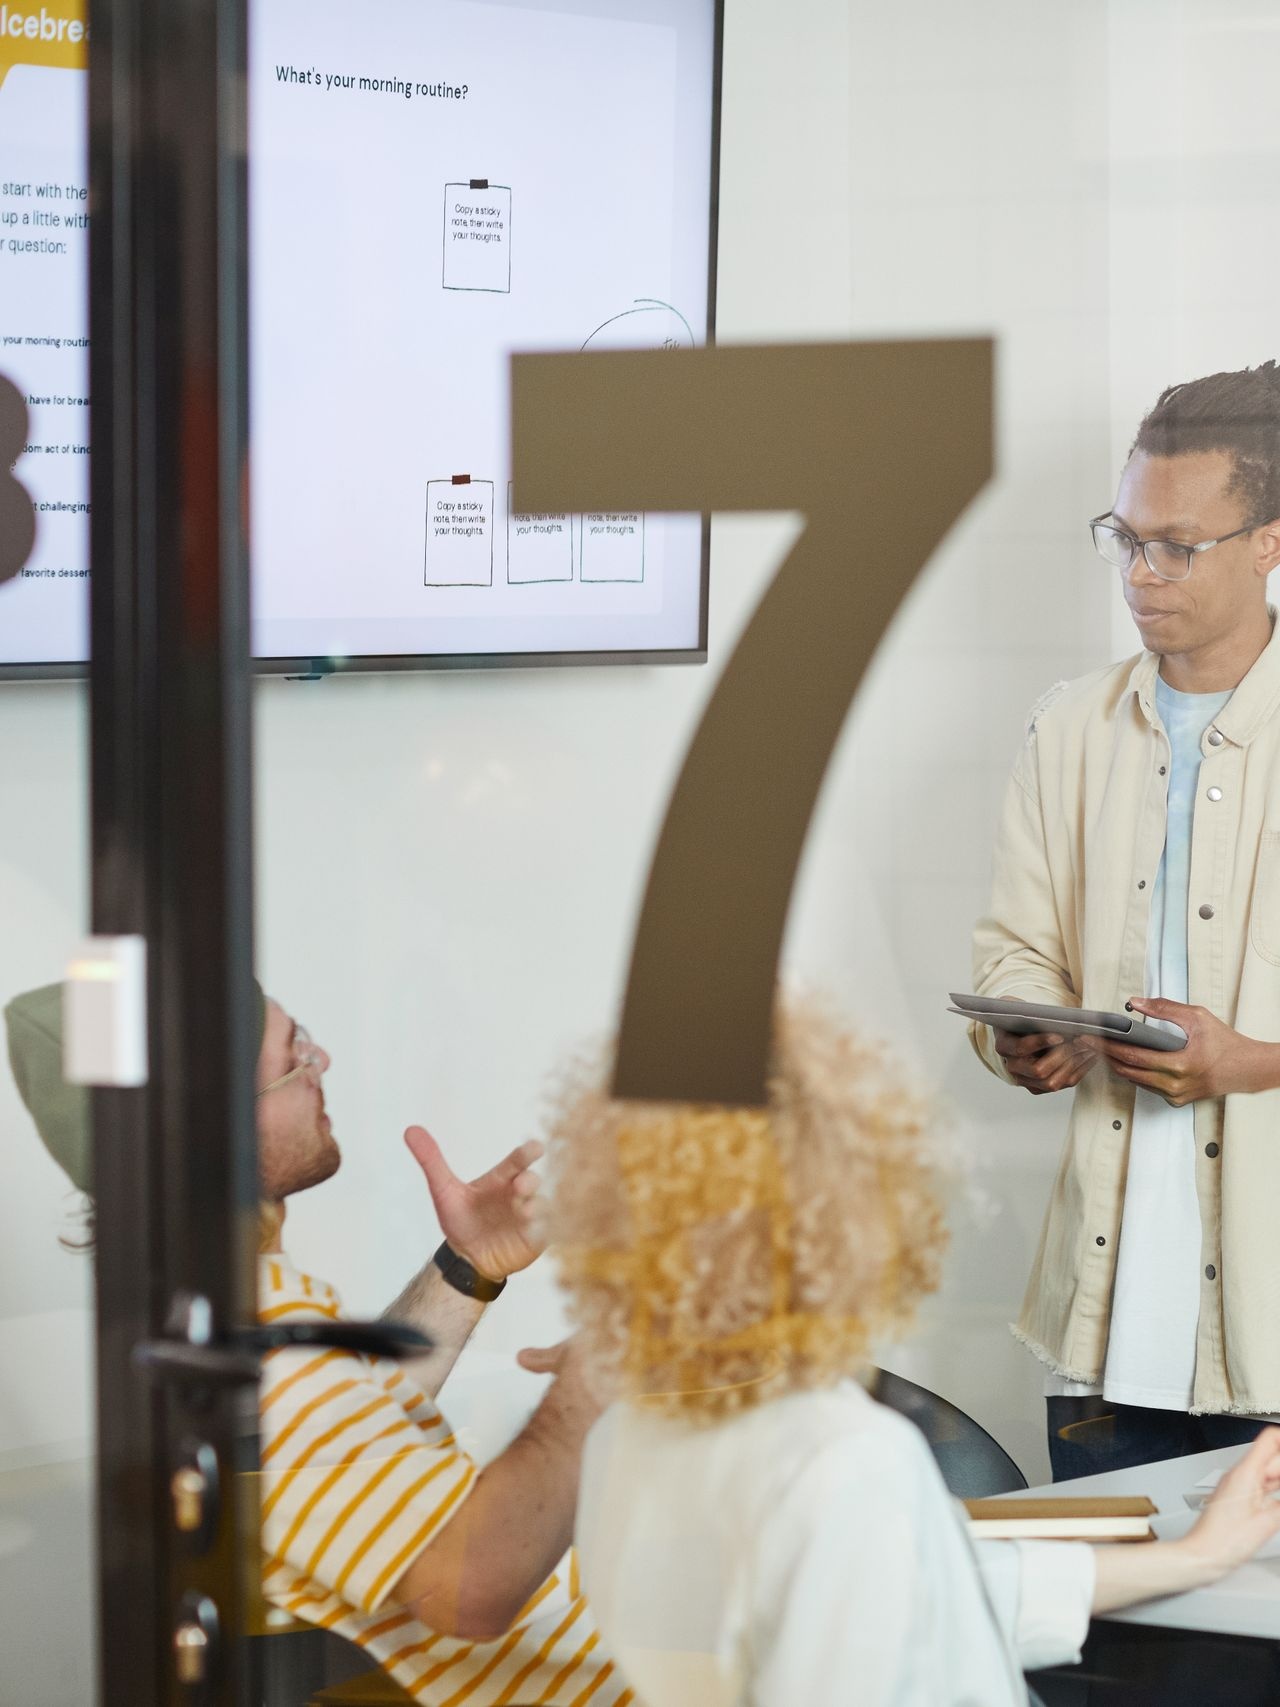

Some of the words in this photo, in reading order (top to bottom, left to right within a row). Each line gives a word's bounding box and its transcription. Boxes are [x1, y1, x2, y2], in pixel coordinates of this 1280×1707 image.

[0, 4, 91, 43] Icebre
[276, 65, 322, 85] What's
[326, 73, 356, 91] your
[359, 76, 413, 98] morning
[416, 81, 469, 100] routine?
[2, 183, 31, 197] start
[36, 183, 62, 199] with
[66, 185, 88, 200] the
[455, 203, 474, 216] Copy
[475, 207, 480, 215] a
[480, 206, 501, 218] sticky
[2, 212, 18, 227] up
[22, 213, 29, 225] a
[33, 210, 60, 227] little
[470, 218, 485, 228] then
[486, 220, 504, 230] write
[453, 231, 469, 241] your
[8, 239, 67, 255] question:
[3, 336, 22, 346] your
[25, 336, 61, 349] morning
[29, 395, 51, 405] have
[53, 395, 66, 406] for
[45, 445, 59, 454] act
[62, 445, 70, 454] of
[437, 500, 456, 512] Copy
[462, 501, 483, 512] sticky
[451, 514, 467, 523] then
[468, 515, 486, 524] write
[435, 527, 451, 537] your
[516, 526, 531, 537] your
[590, 526, 605, 536] your
[21, 567, 56, 577] favorite
[509, 337, 998, 1106] 7
